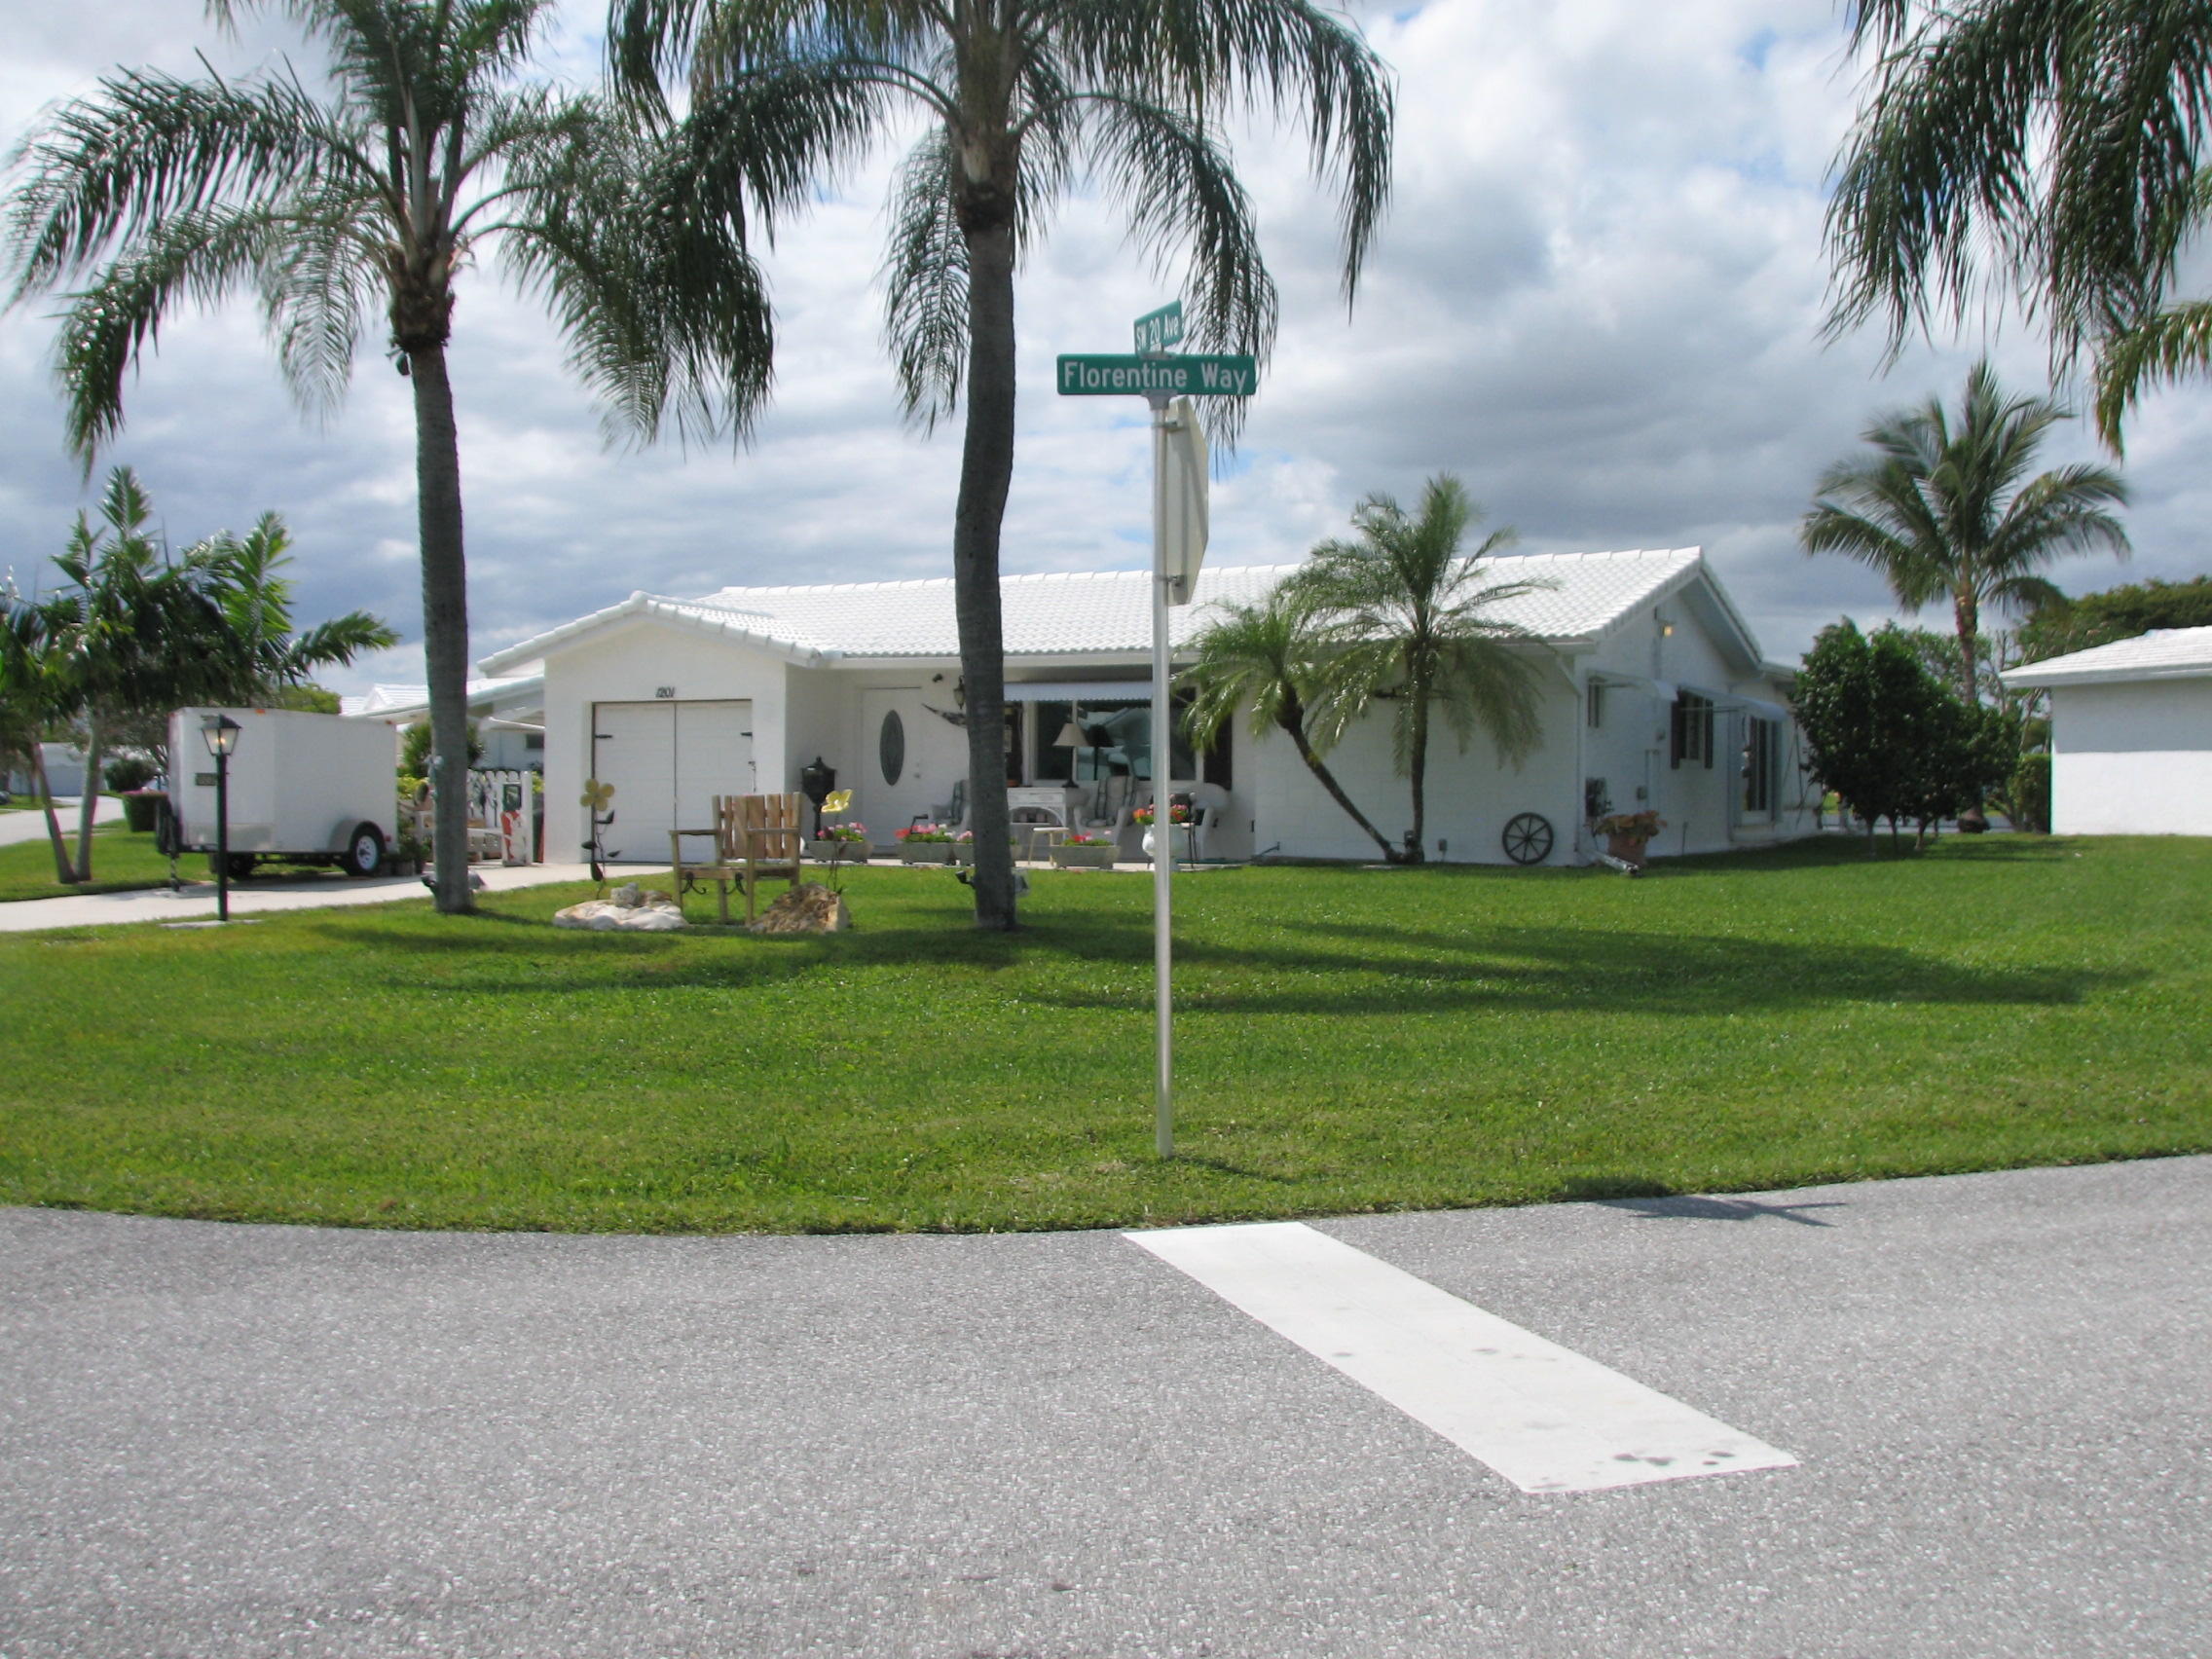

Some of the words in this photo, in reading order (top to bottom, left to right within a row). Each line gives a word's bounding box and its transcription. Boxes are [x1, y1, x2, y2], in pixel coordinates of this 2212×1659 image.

[1149, 316, 1161, 345] 20
[1163, 313, 1179, 340] Ave
[1063, 361, 1188, 388] Florentine
[1200, 361, 1247, 394] Way
